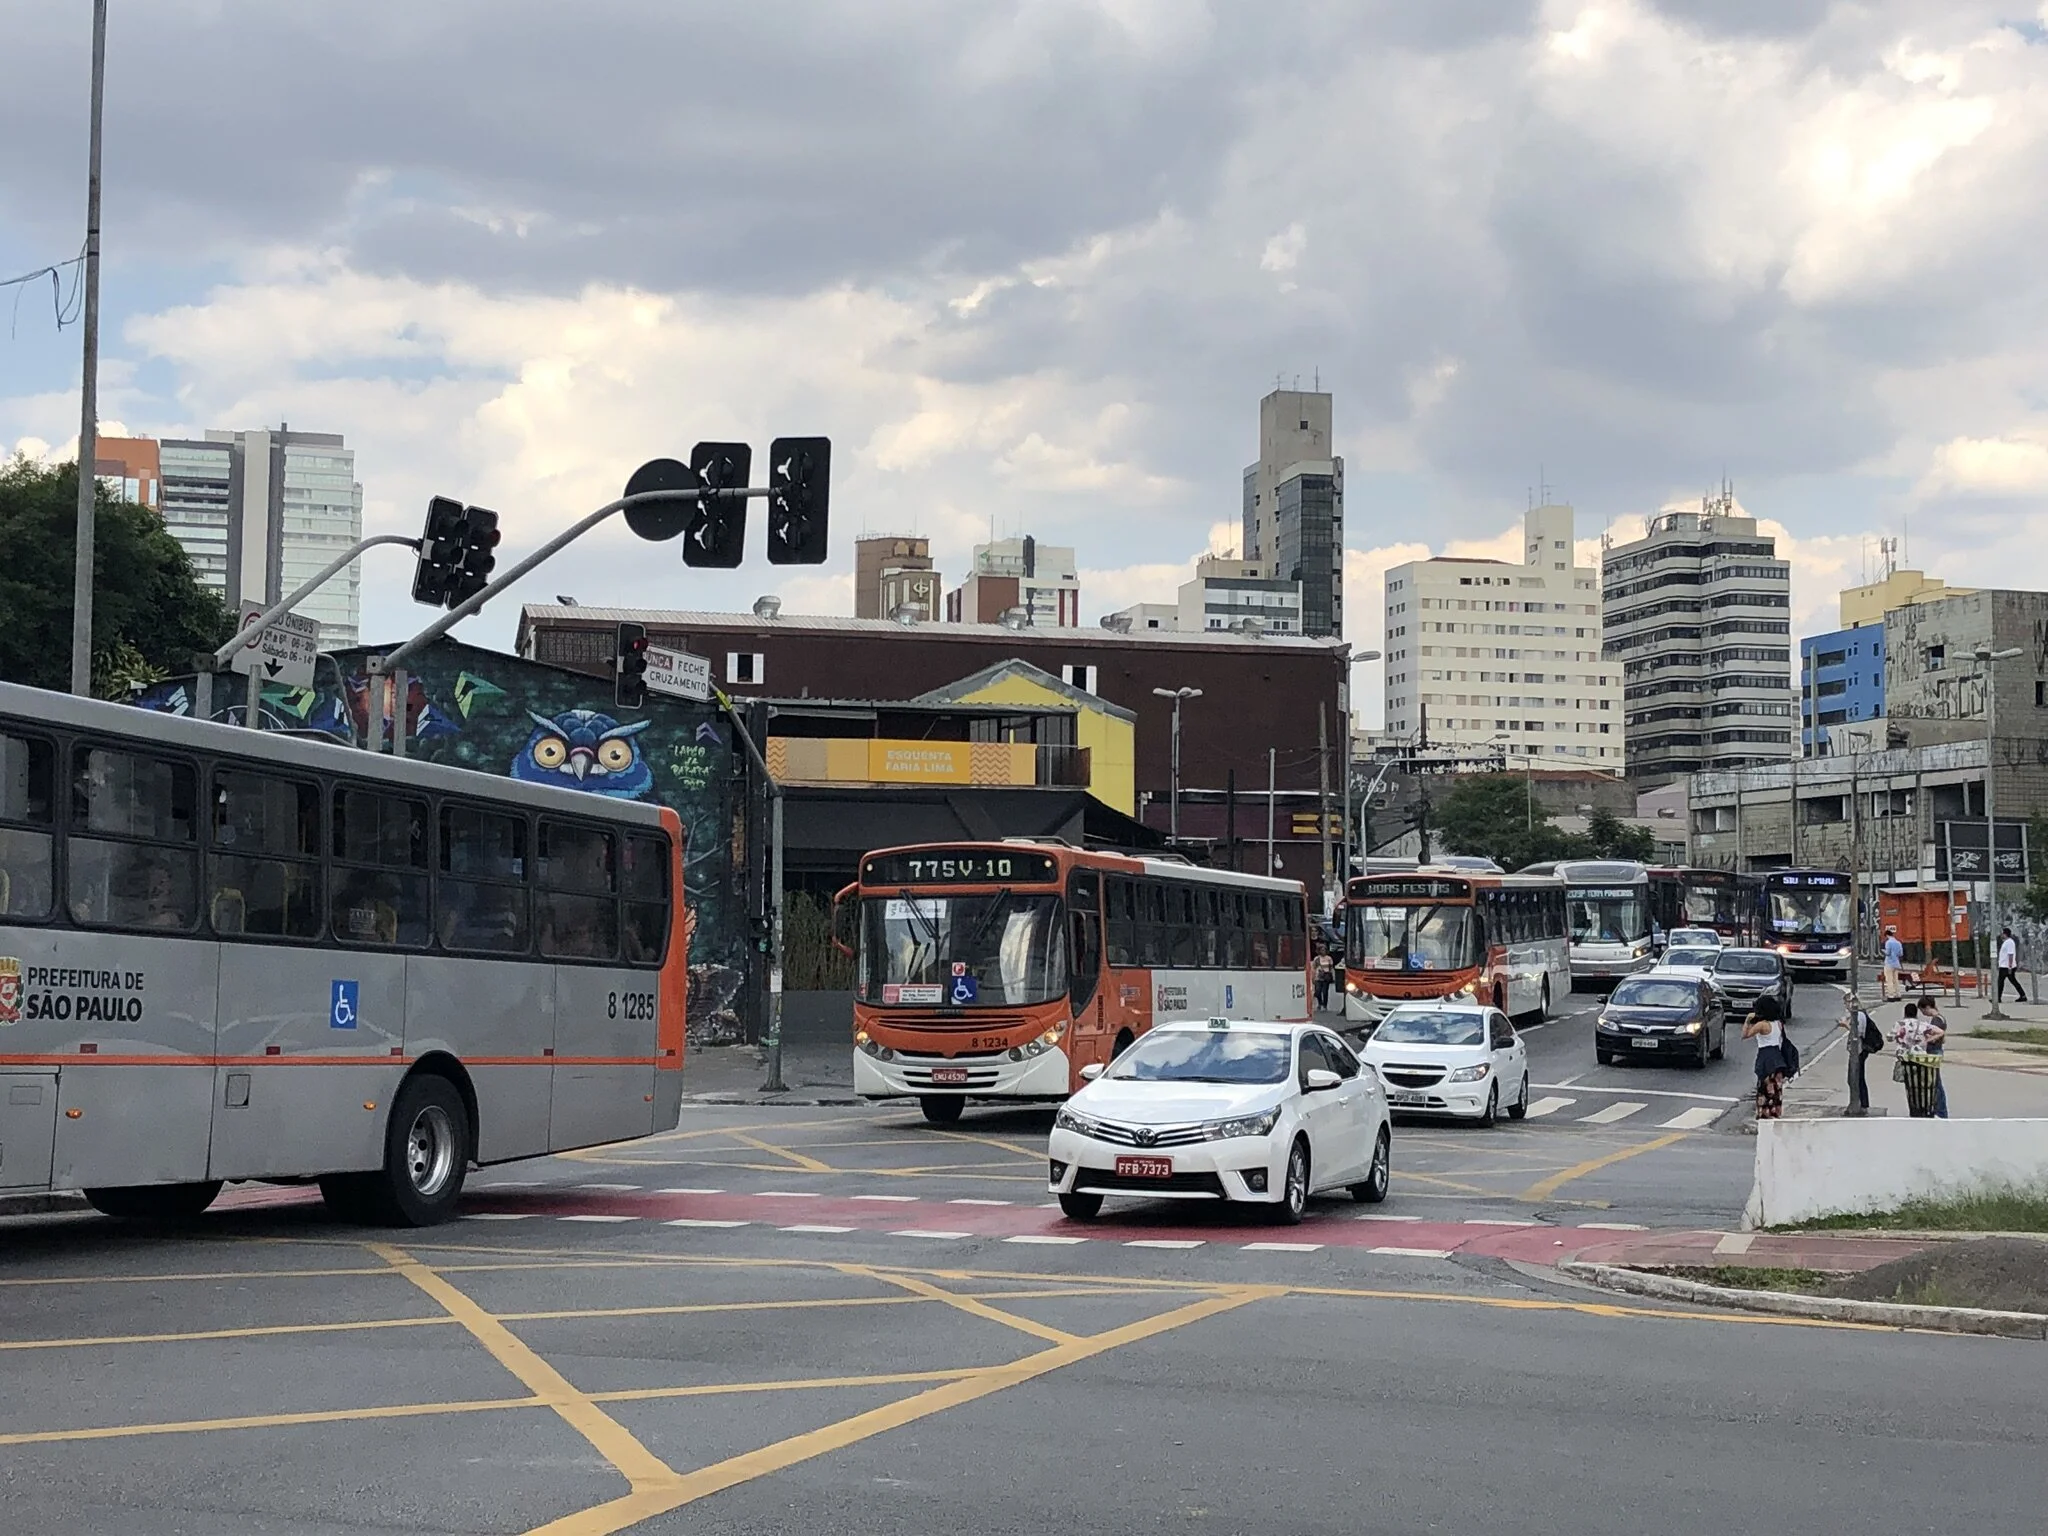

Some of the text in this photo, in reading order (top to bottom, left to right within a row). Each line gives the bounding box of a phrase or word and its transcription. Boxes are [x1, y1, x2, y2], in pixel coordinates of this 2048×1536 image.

[678, 660, 705, 676] FECHE
[649, 671, 706, 693] CRUZAMENTO
[887, 750, 952, 761] ESQUENTA
[886, 762, 954, 773] FARIA LIMA
[28, 966, 144, 990] PREFEITURA DE
[26, 989, 142, 1022] SÃO PAULO
[608, 991, 654, 1020] 8 1285
[1210, 1018, 1227, 1028] TAXI
[971, 1037, 1008, 1048] 8 1234
